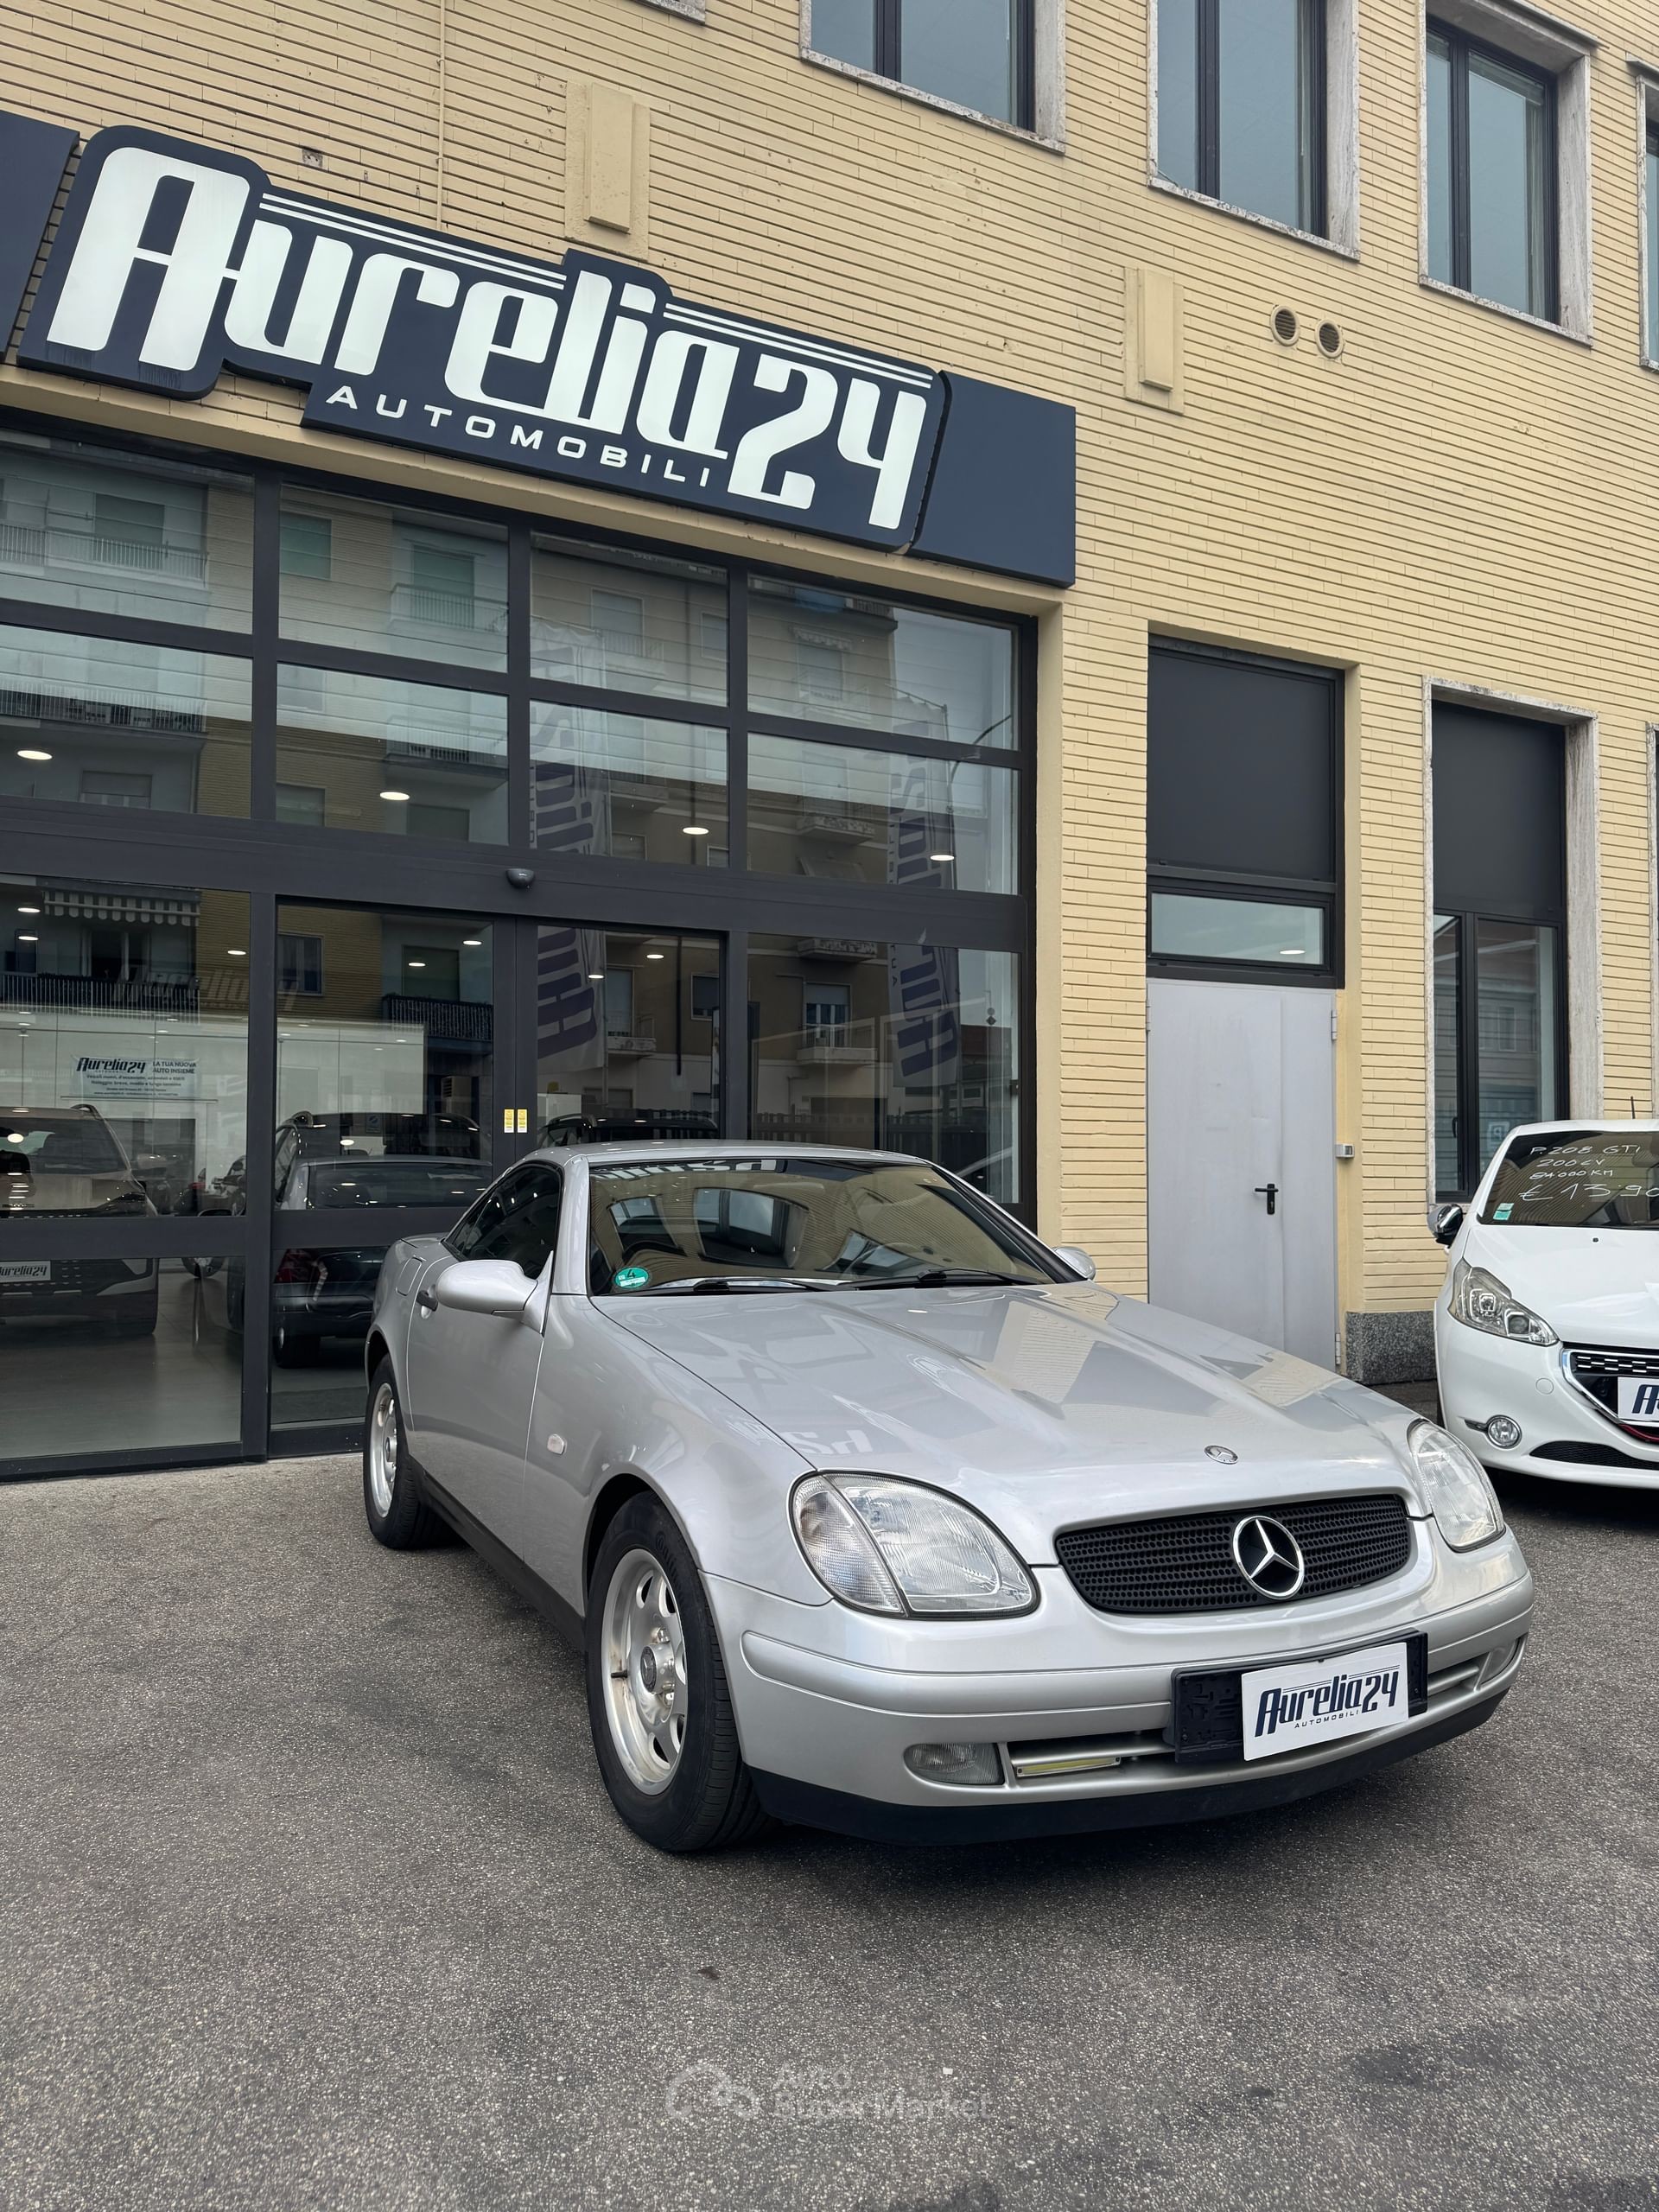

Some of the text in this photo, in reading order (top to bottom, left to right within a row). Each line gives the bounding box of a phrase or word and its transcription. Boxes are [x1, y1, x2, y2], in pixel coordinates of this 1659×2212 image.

[47, 146, 927, 530] Aurelia24
[325, 385, 710, 487] AUTOMOBILI
[76, 1057, 146, 1073] Aurelia24
[1603, 1145, 1641, 1154] GTI
[0, 1265, 48, 1276] urelia24
[627, 1268, 637, 1278] 4
[1255, 1670, 1400, 1738] Aurelia24
[1294, 1709, 1360, 1729] AUTOMOBILI
